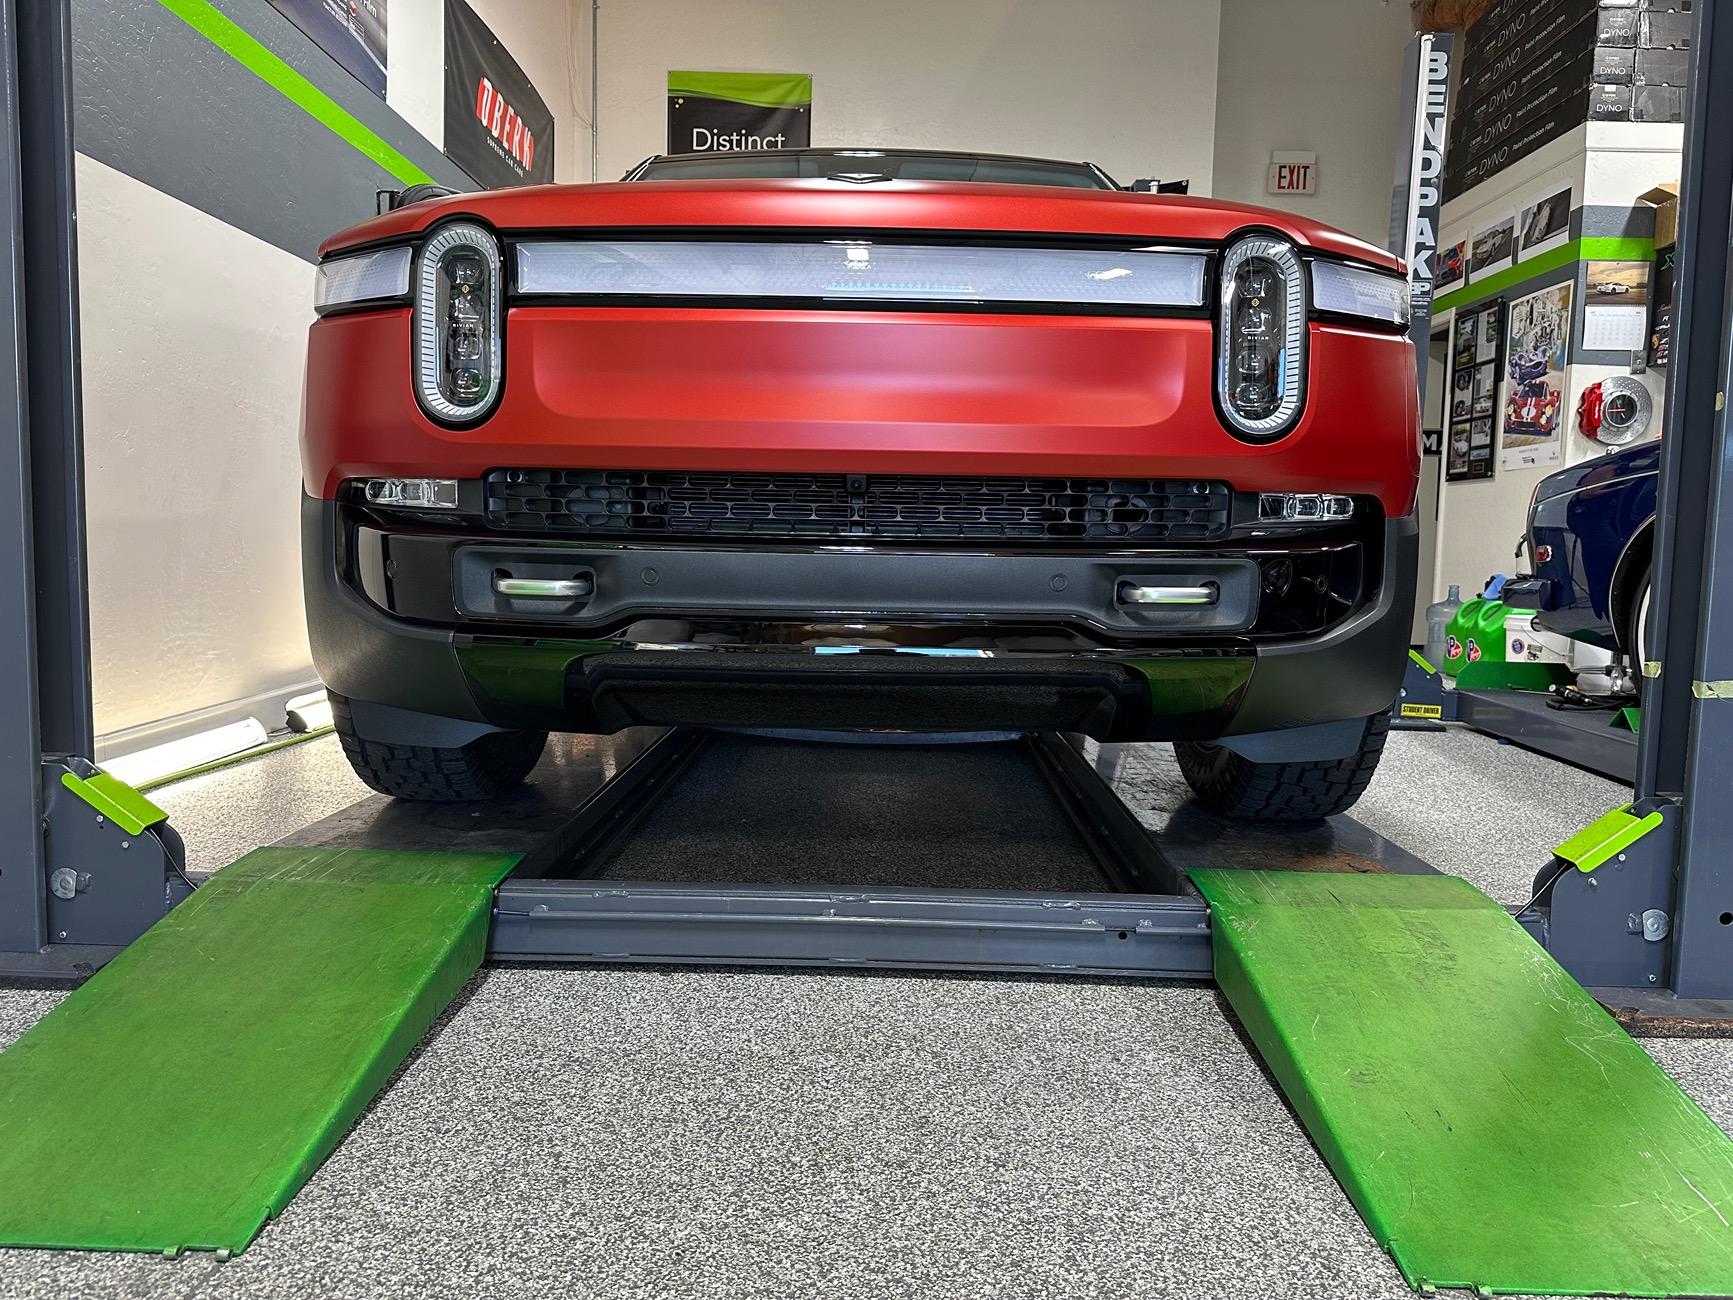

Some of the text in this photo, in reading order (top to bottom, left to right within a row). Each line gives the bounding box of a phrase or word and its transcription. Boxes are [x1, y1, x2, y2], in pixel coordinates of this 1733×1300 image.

[1498, 13, 1525, 47] DYNO
[1603, 28, 1630, 37] DYNO
[1493, 47, 1520, 80] DYNO
[1600, 66, 1626, 75] DYNO
[1489, 81, 1517, 112] DYNO
[1596, 104, 1623, 112] DYNO
[480, 77, 532, 171] OBERK
[1484, 113, 1512, 144] DYNO
[692, 128, 786, 150] Distinct
[1411, 51, 1449, 278] BENDPAK
[1479, 146, 1508, 175] DYNO
[1277, 165, 1310, 190] EXIT
[1422, 434, 1442, 450] M
